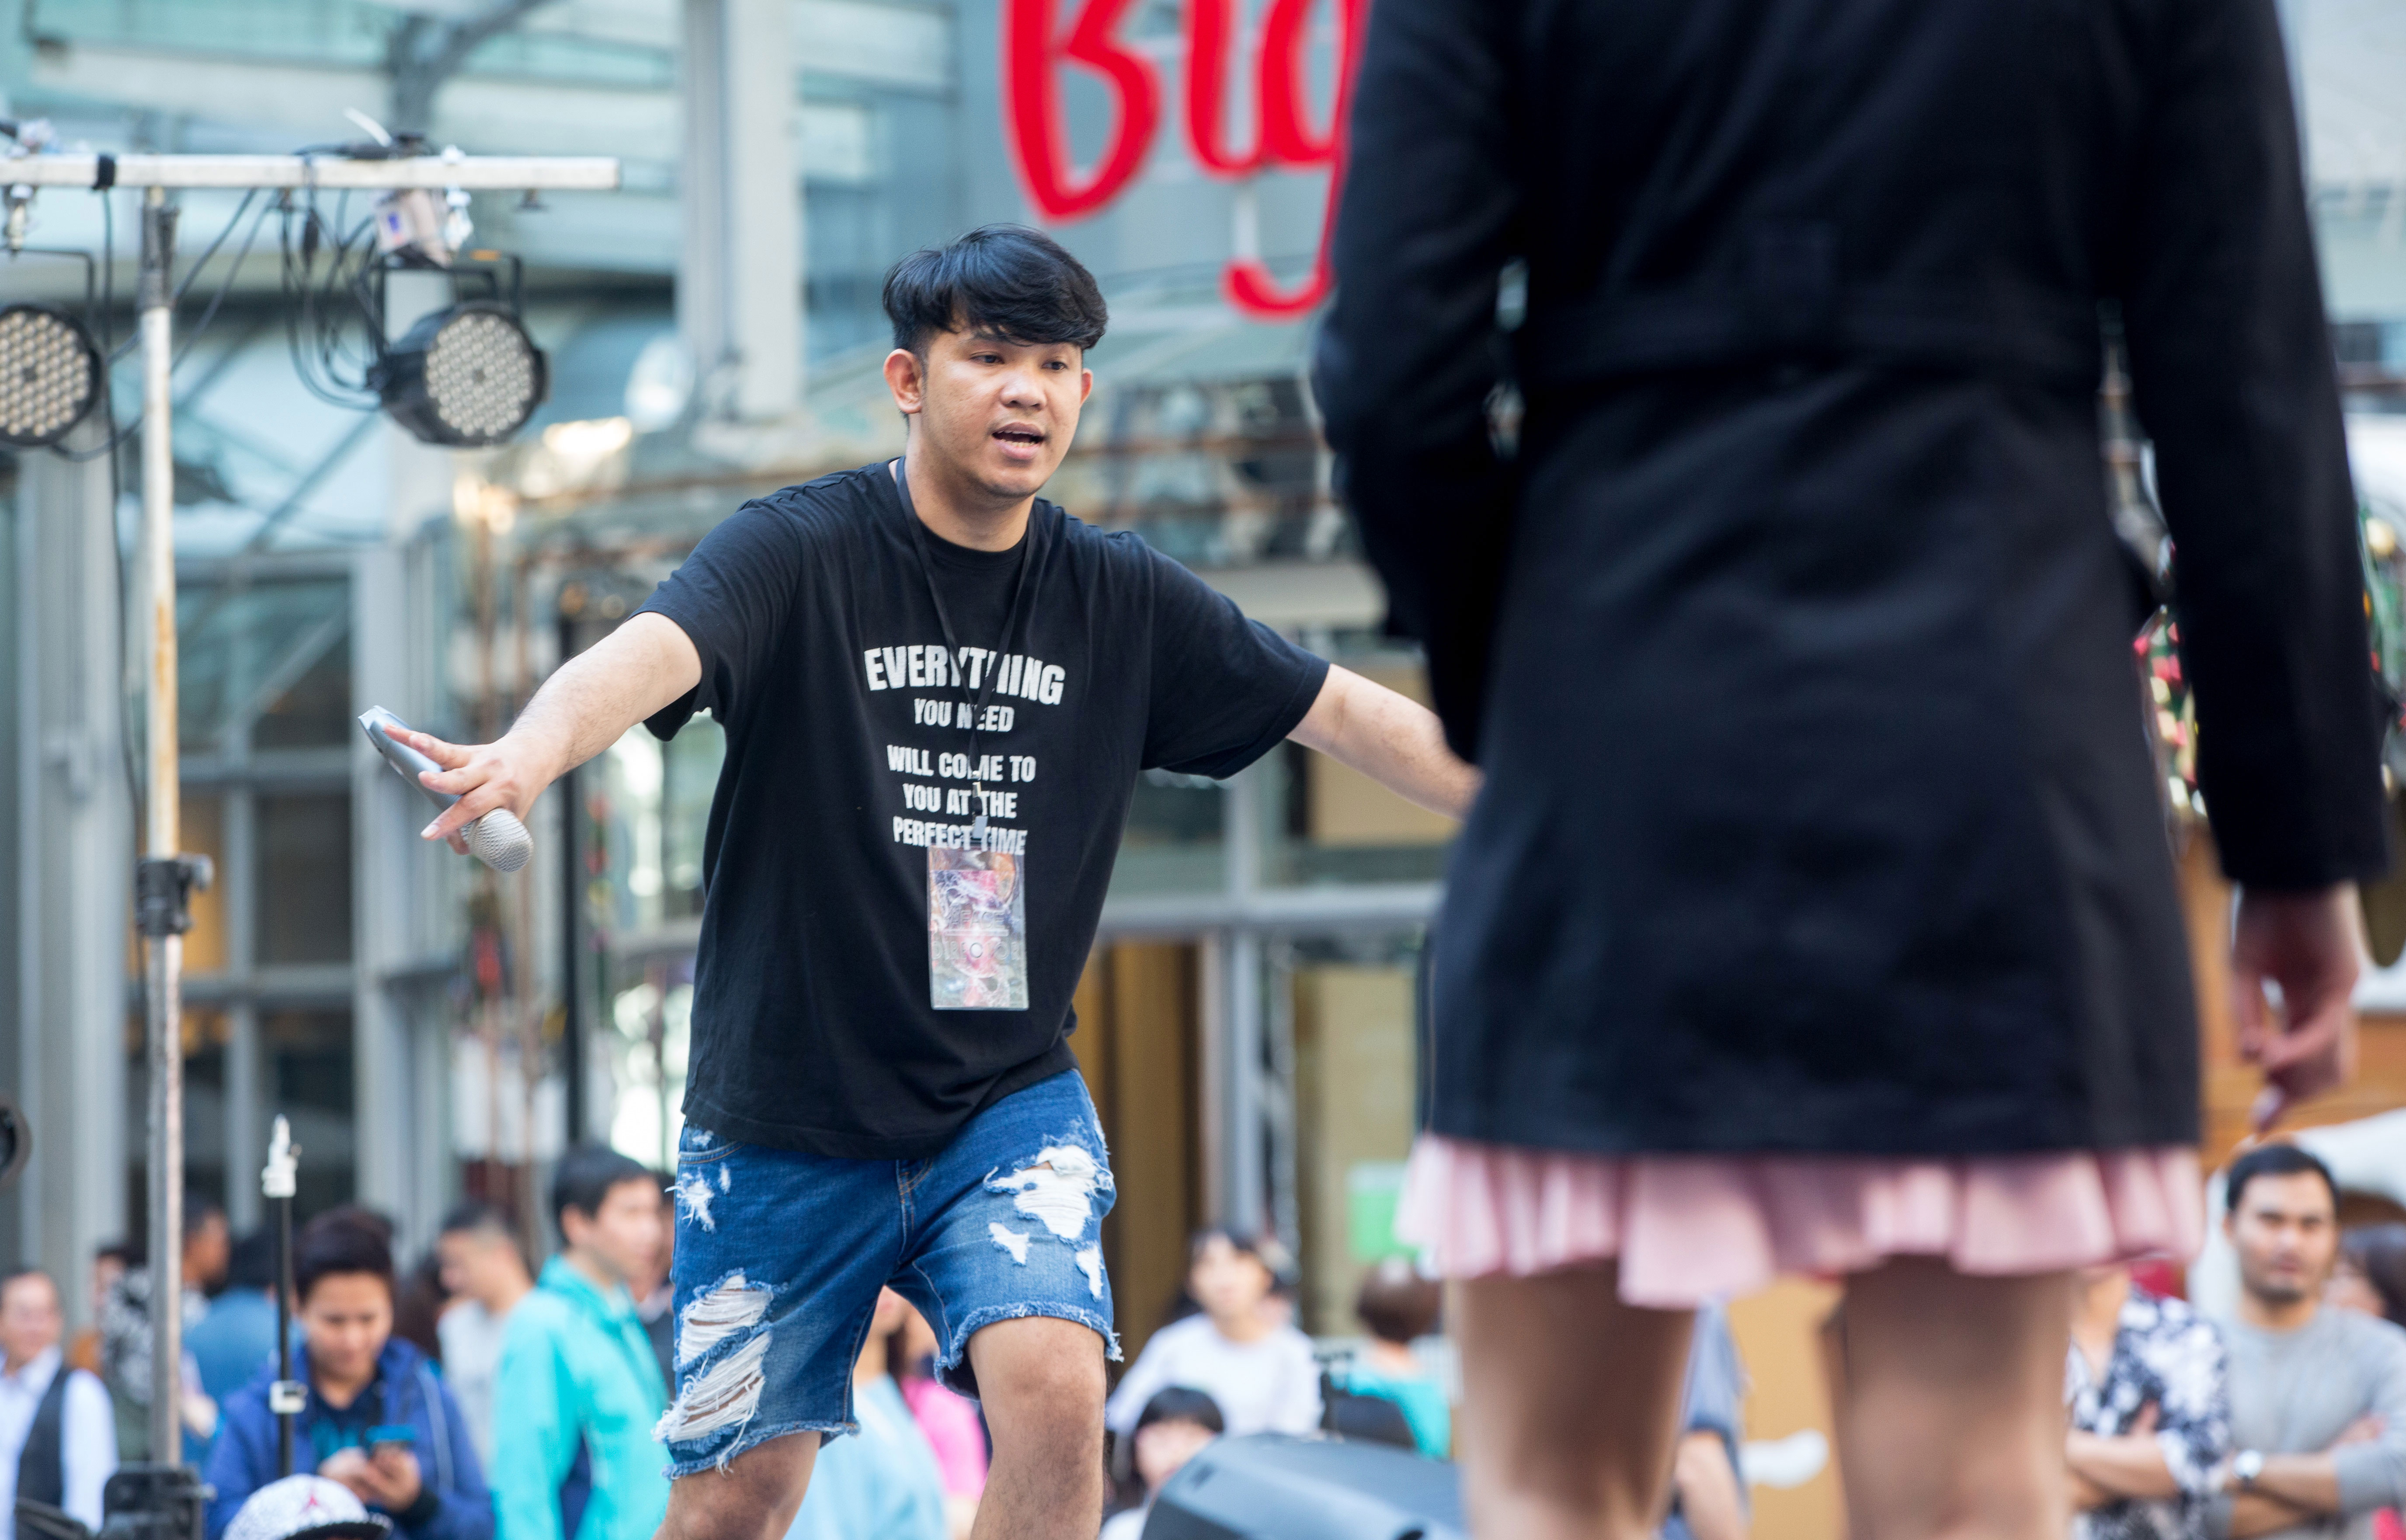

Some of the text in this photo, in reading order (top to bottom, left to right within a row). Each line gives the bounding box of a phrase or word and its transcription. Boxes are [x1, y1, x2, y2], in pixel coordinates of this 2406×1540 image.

[914, 698, 952, 727] YOU
[887, 745, 1036, 782] WILL COME TO
[903, 784, 1018, 819] YOU AT THE
[893, 816, 1028, 856] PERFECT TIME
